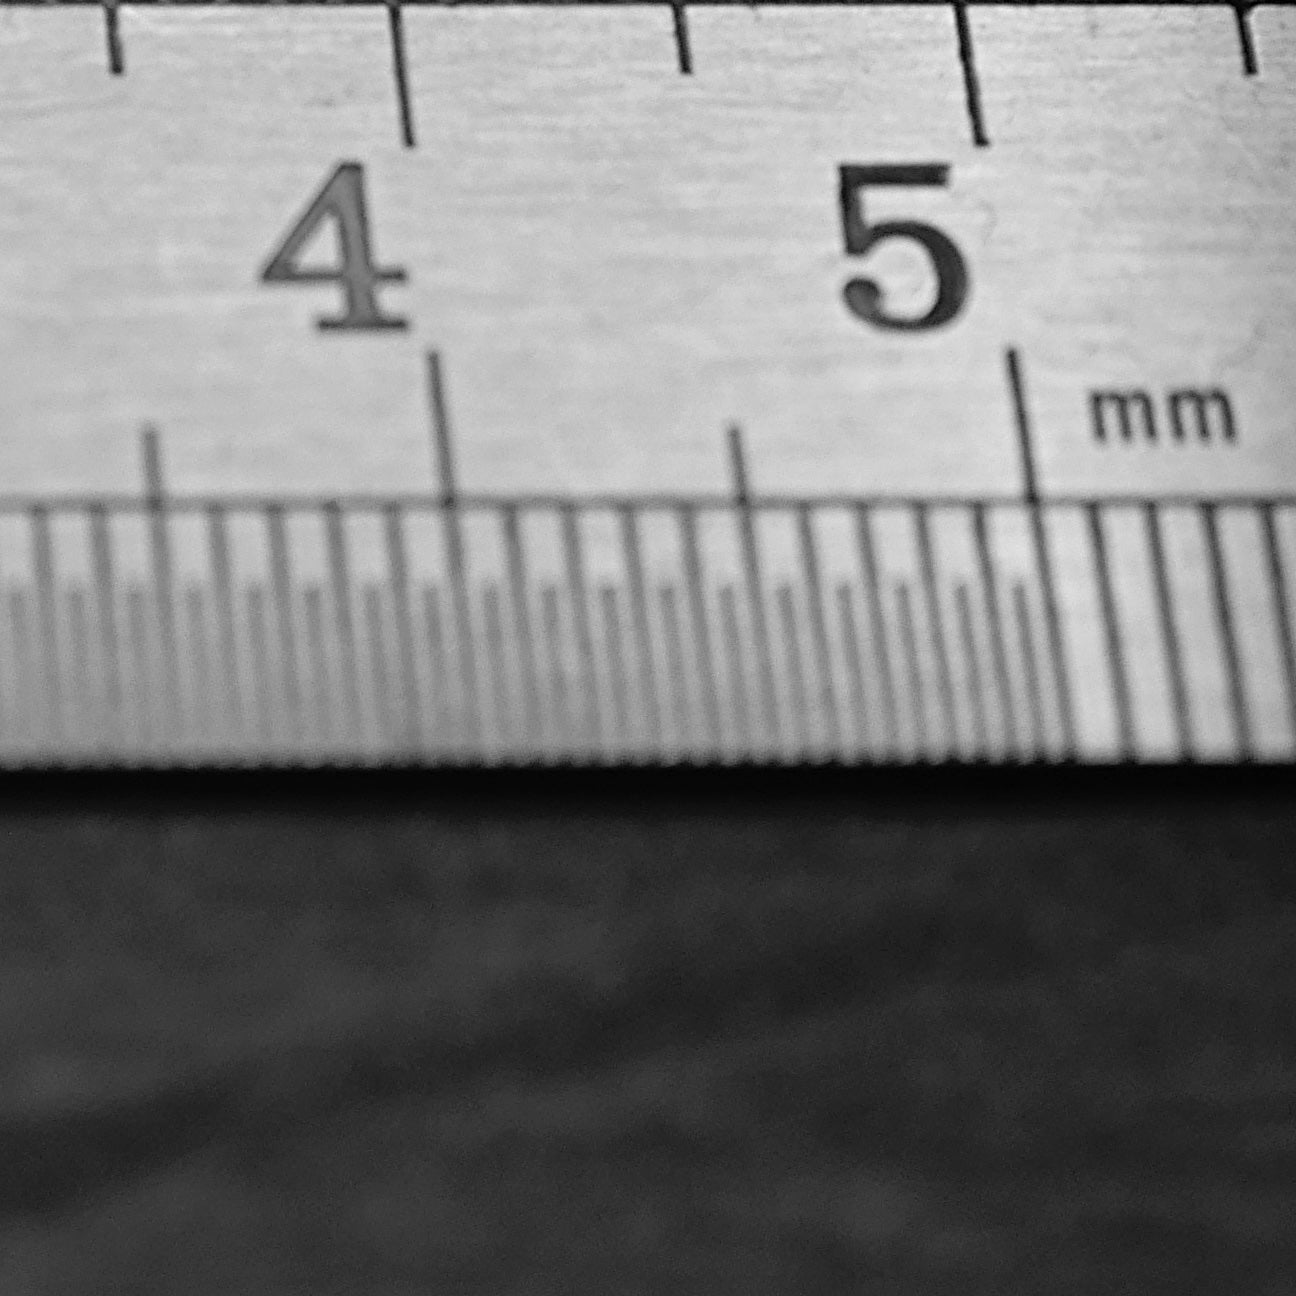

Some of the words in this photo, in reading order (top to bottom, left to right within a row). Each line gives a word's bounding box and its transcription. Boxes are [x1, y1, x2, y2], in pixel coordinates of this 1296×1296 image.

[259, 160, 409, 332] 4
[835, 161, 971, 335] 5
[1088, 385, 1237, 445] mm
